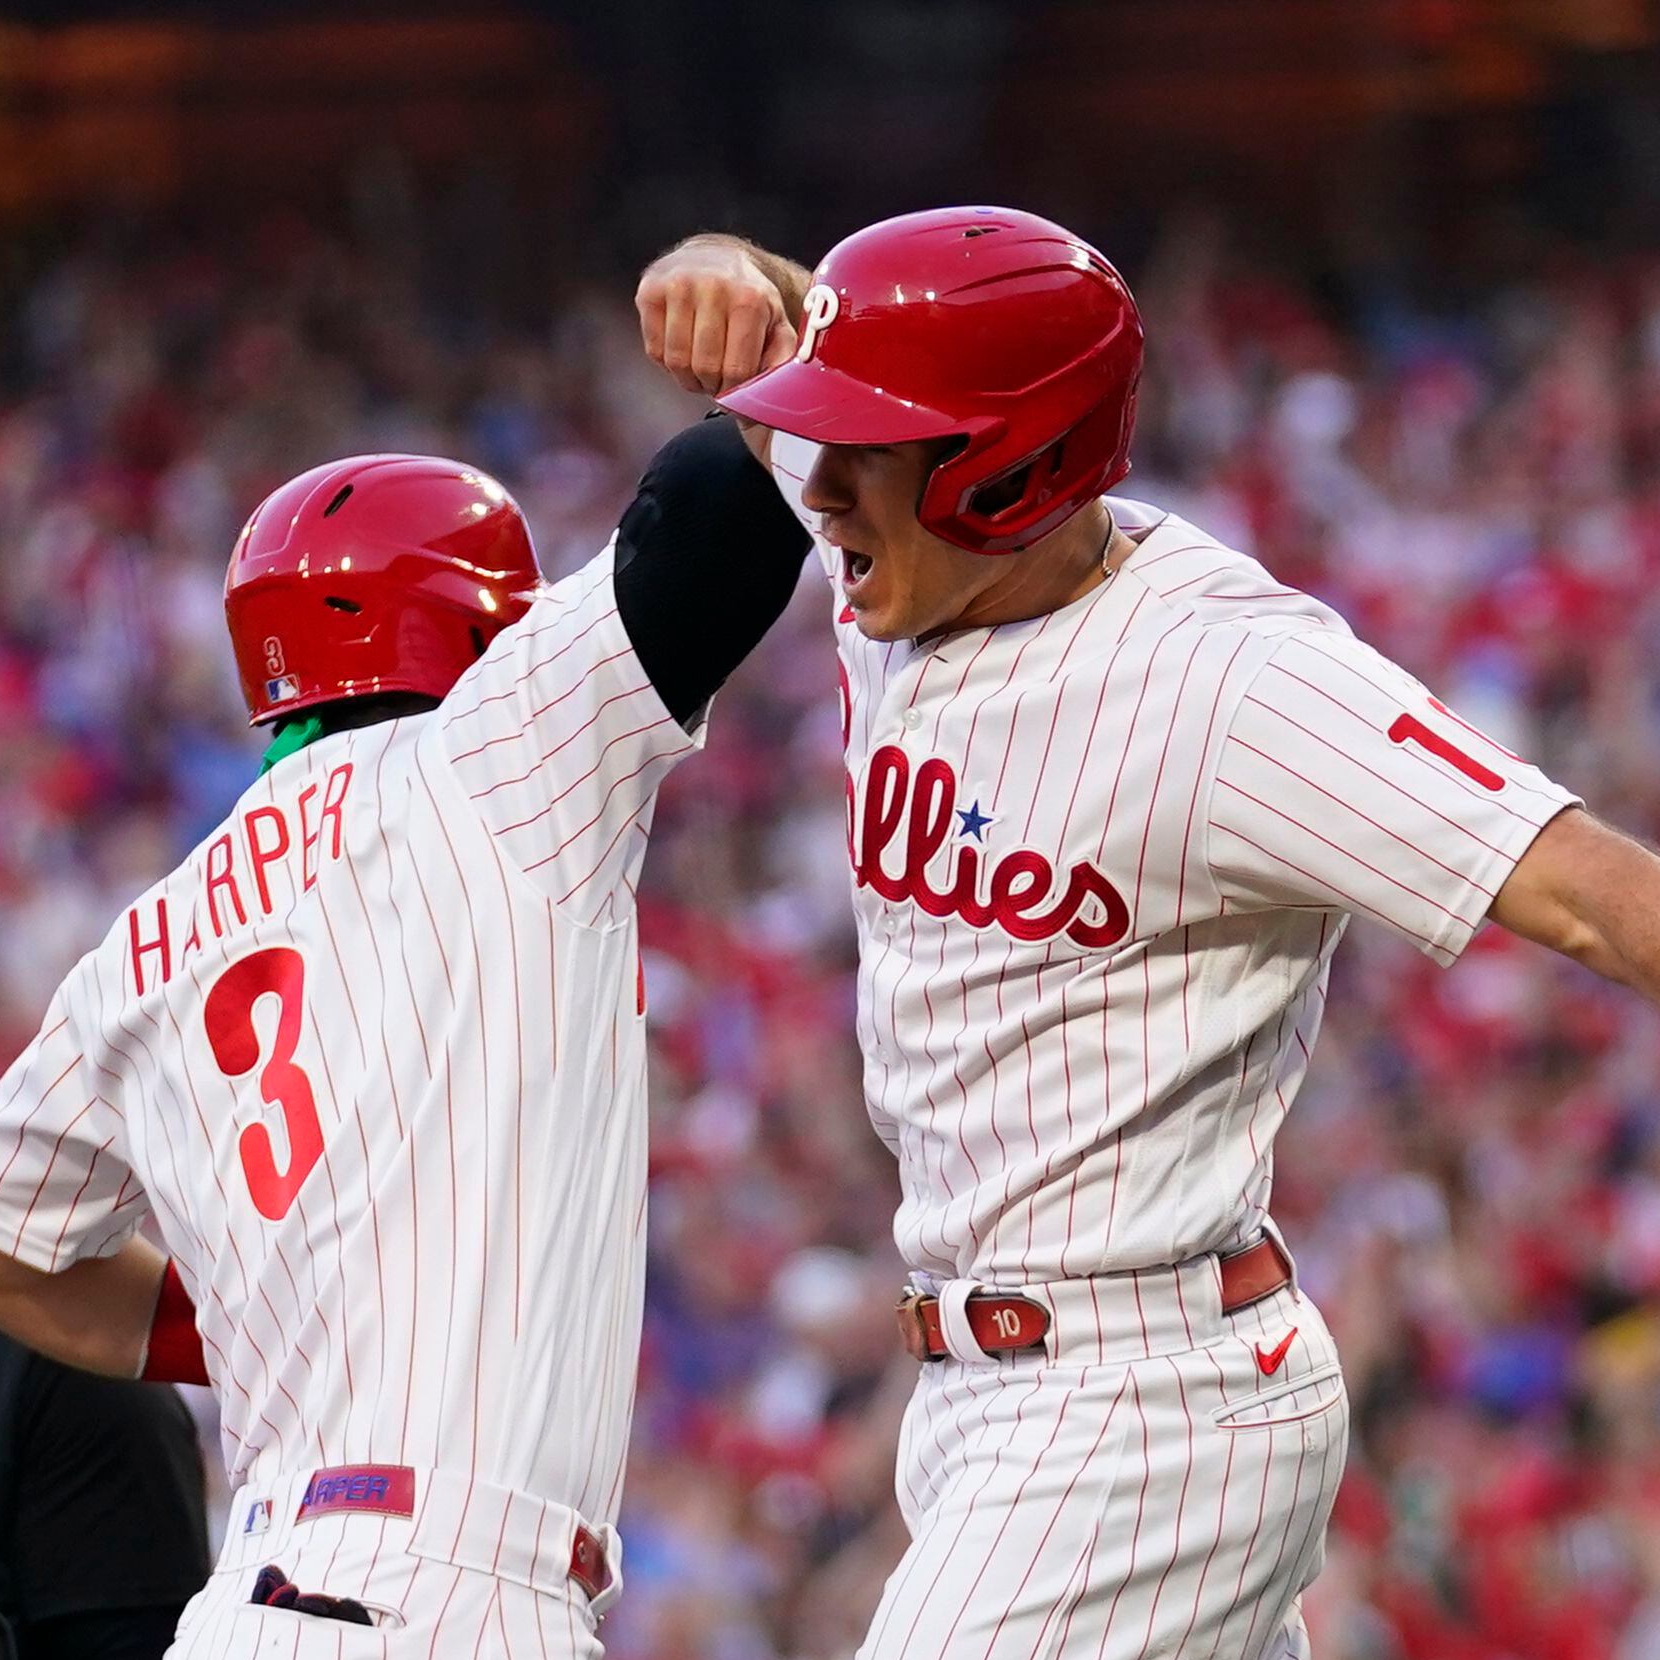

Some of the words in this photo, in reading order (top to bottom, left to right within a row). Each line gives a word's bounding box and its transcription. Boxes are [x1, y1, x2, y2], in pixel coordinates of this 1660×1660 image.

[804, 284, 839, 363] P
[1387, 696, 1530, 792] 1
[845, 744, 1130, 948] llies
[204, 946, 324, 1221] 3
[991, 1308, 1021, 1338] 10
